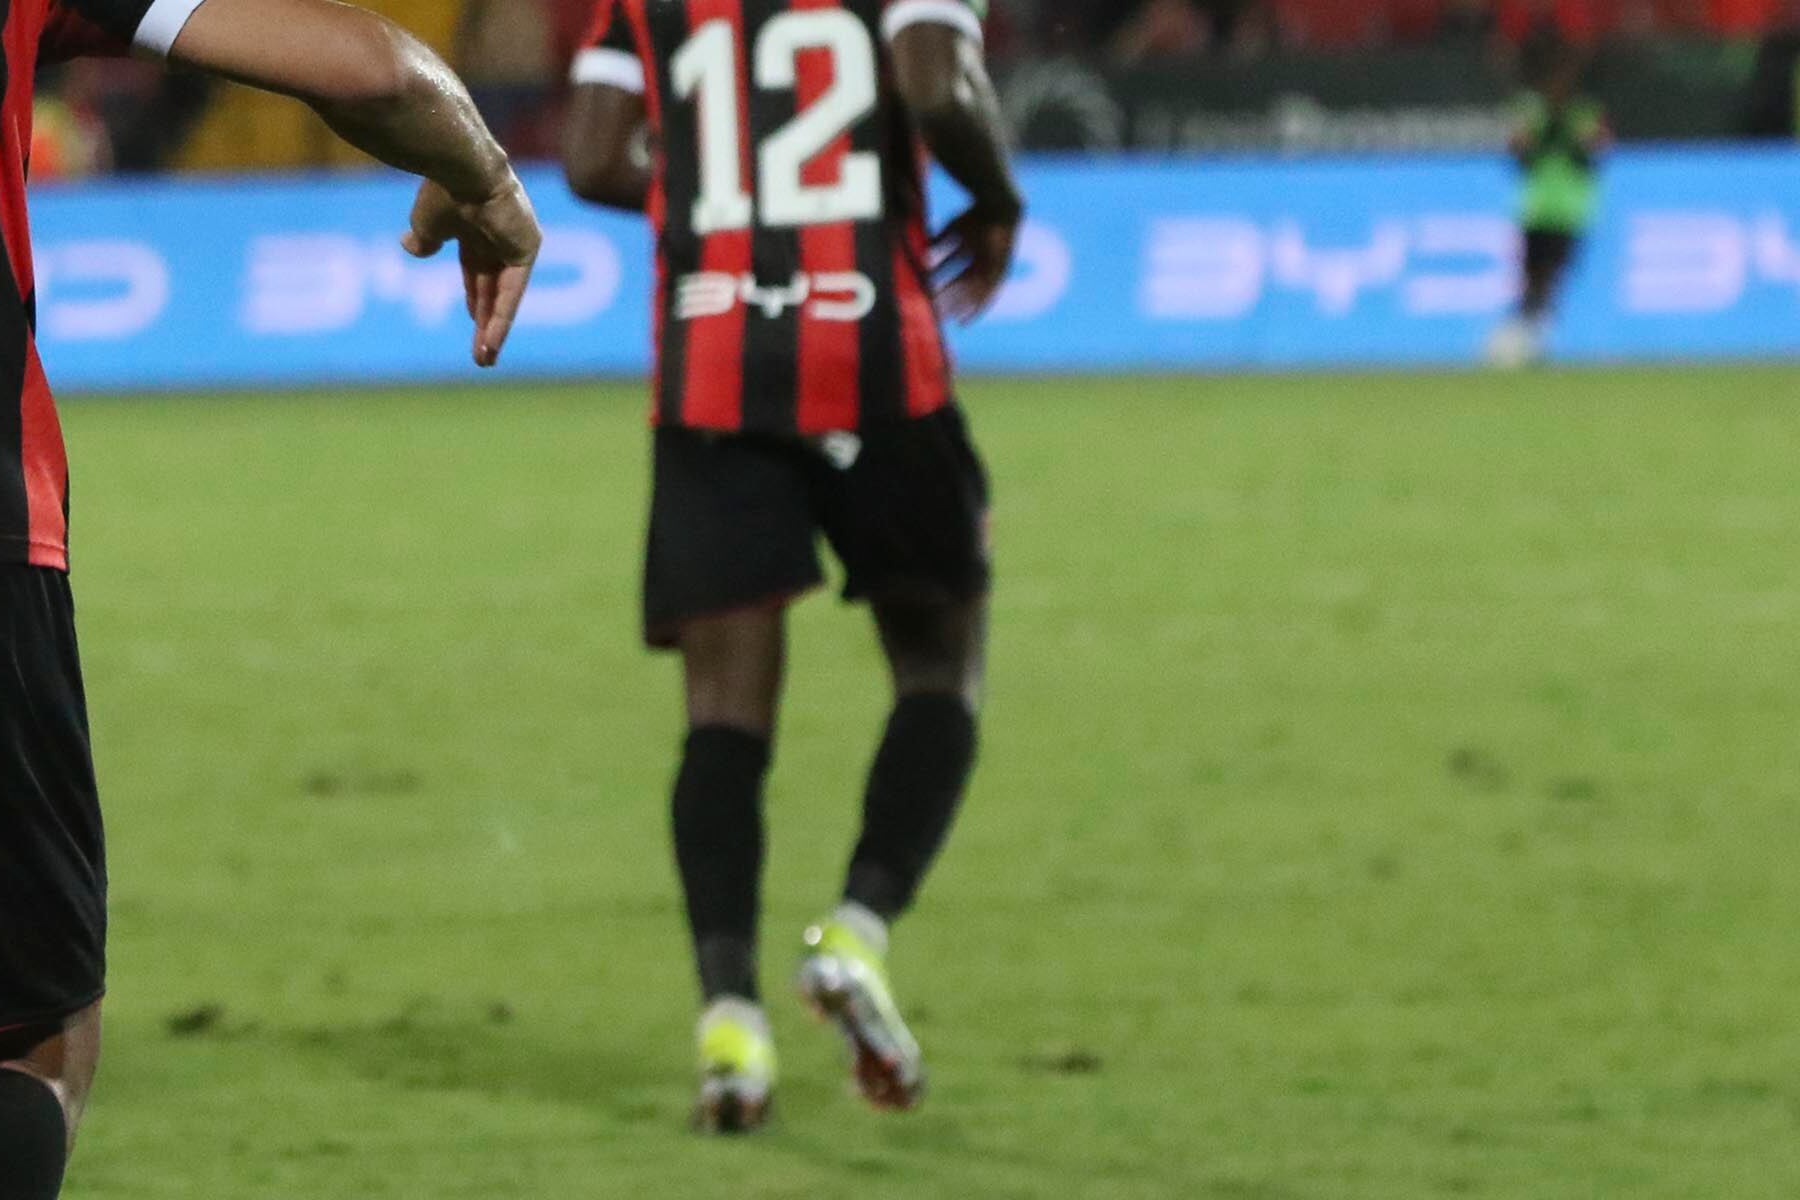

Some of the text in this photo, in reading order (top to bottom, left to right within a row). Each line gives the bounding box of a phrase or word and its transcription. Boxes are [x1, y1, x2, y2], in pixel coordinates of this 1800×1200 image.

[670, 8, 883, 234] 12
[674, 272, 876, 322] BYD
[1138, 217, 1526, 317] BYD
